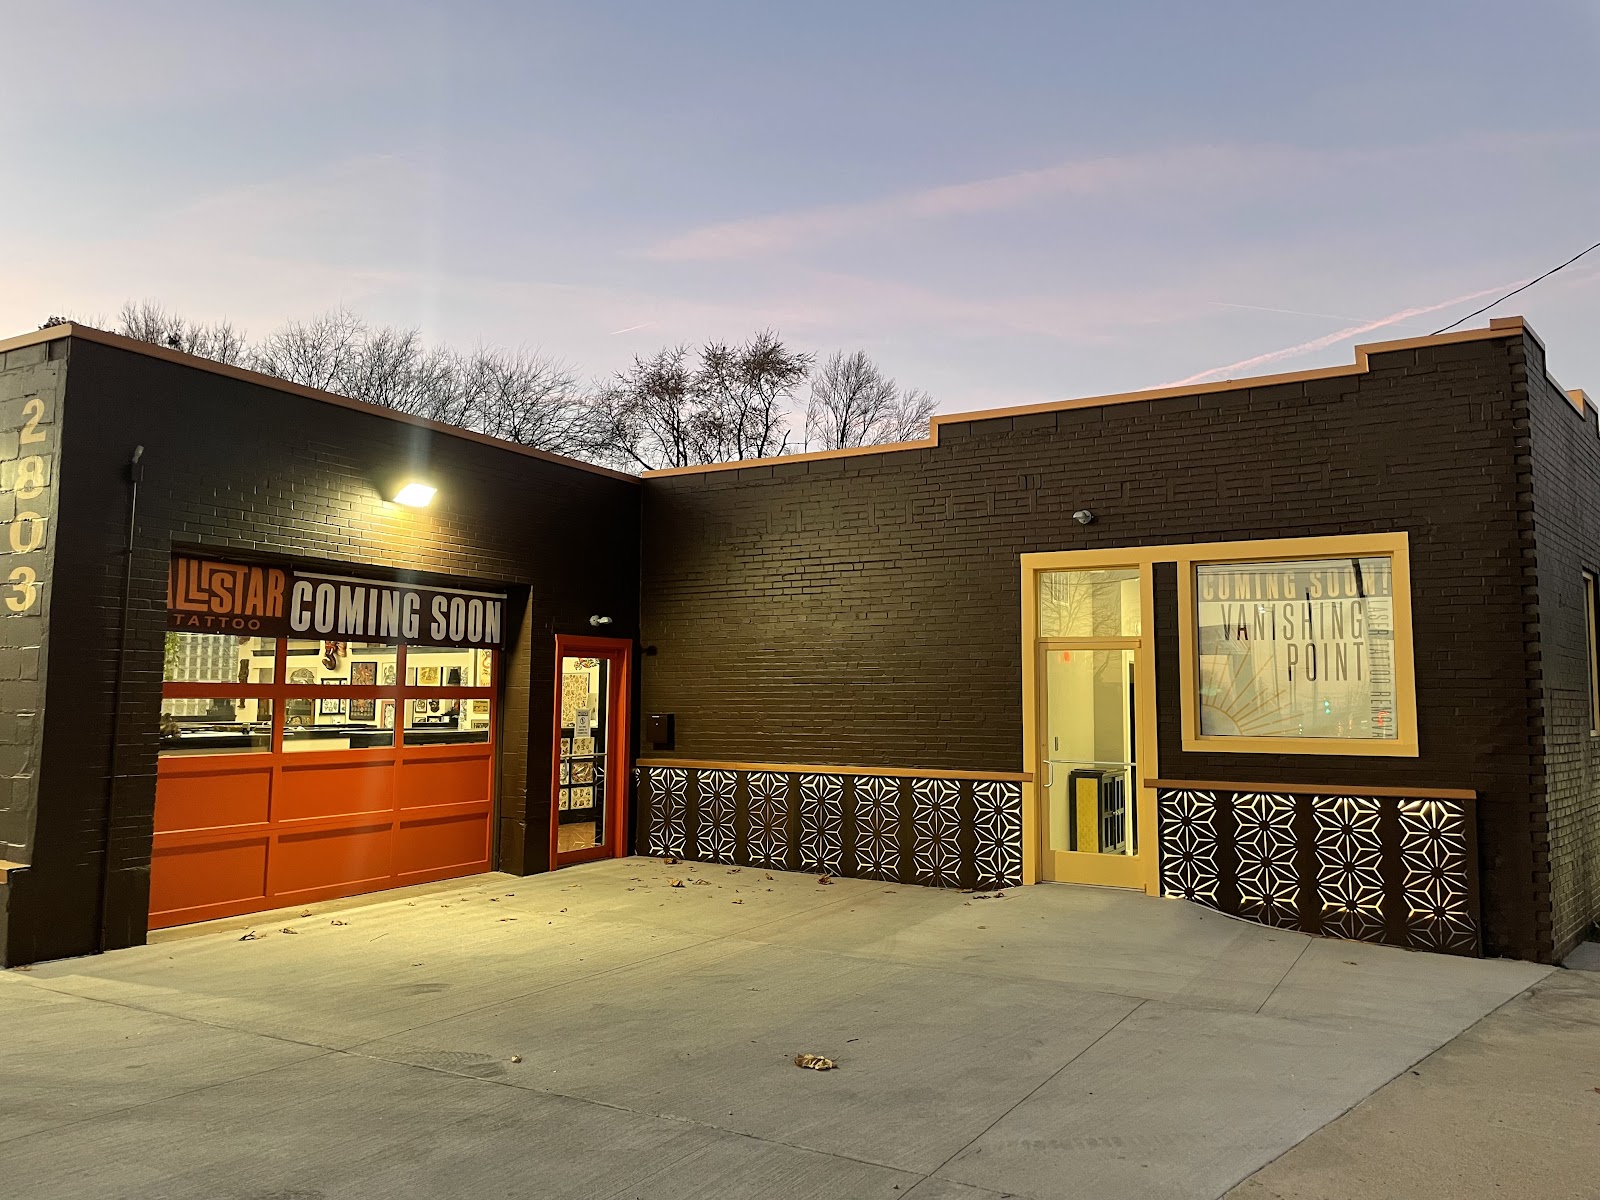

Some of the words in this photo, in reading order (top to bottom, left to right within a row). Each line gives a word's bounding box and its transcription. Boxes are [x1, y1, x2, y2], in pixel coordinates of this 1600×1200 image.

[6, 398, 46, 612] 2803
[1202, 571, 1296, 600] COMING
[1310, 563, 1390, 599] SOON!
[173, 613, 261, 630] TATTOO
[290, 580, 420, 639] COMING
[430, 594, 501, 644] SOON
[1221, 601, 1363, 641] VANISHING
[1367, 600, 1389, 636] LASER
[1287, 642, 1364, 682] POINT
[1368, 642, 1391, 684] TATTOO
[1370, 691, 1393, 738] REMOVA
